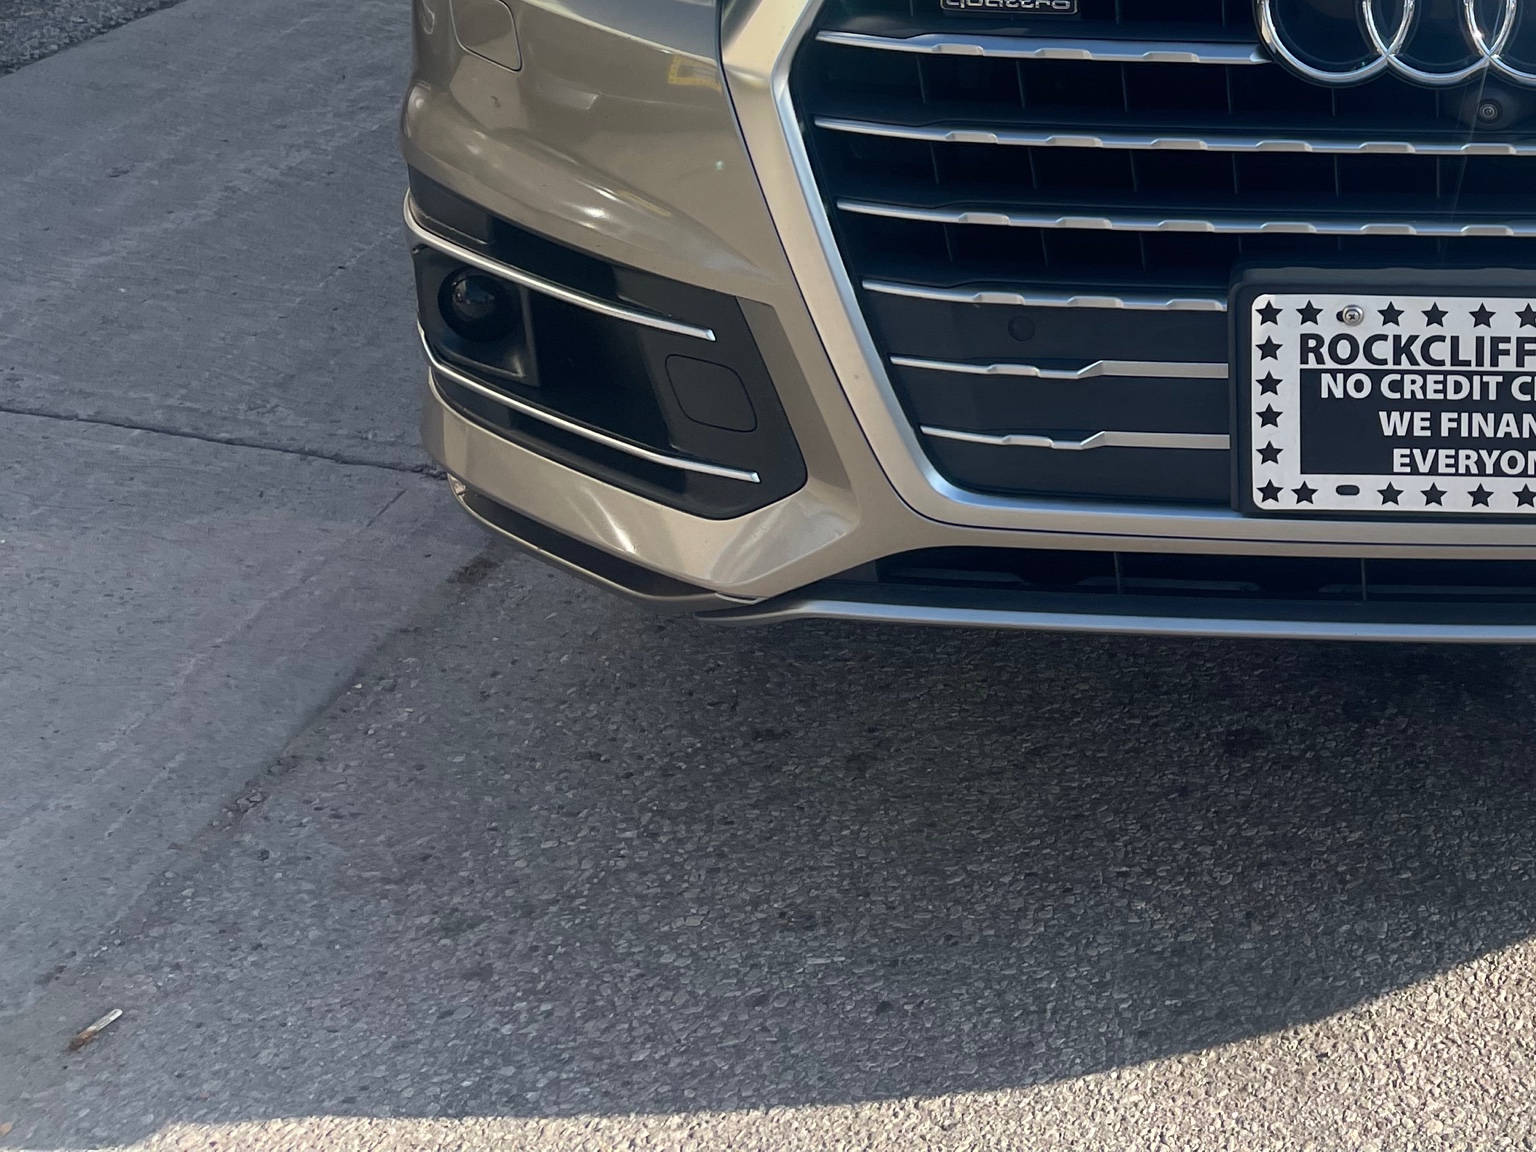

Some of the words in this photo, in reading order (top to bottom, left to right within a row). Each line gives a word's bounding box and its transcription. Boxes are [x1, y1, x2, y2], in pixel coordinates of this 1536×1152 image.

[1300, 332, 1536, 369] ROCKCLIFF
[1320, 373, 1372, 399] NO
[1380, 373, 1503, 401] CREDIT
[1379, 410, 1432, 437] WE
